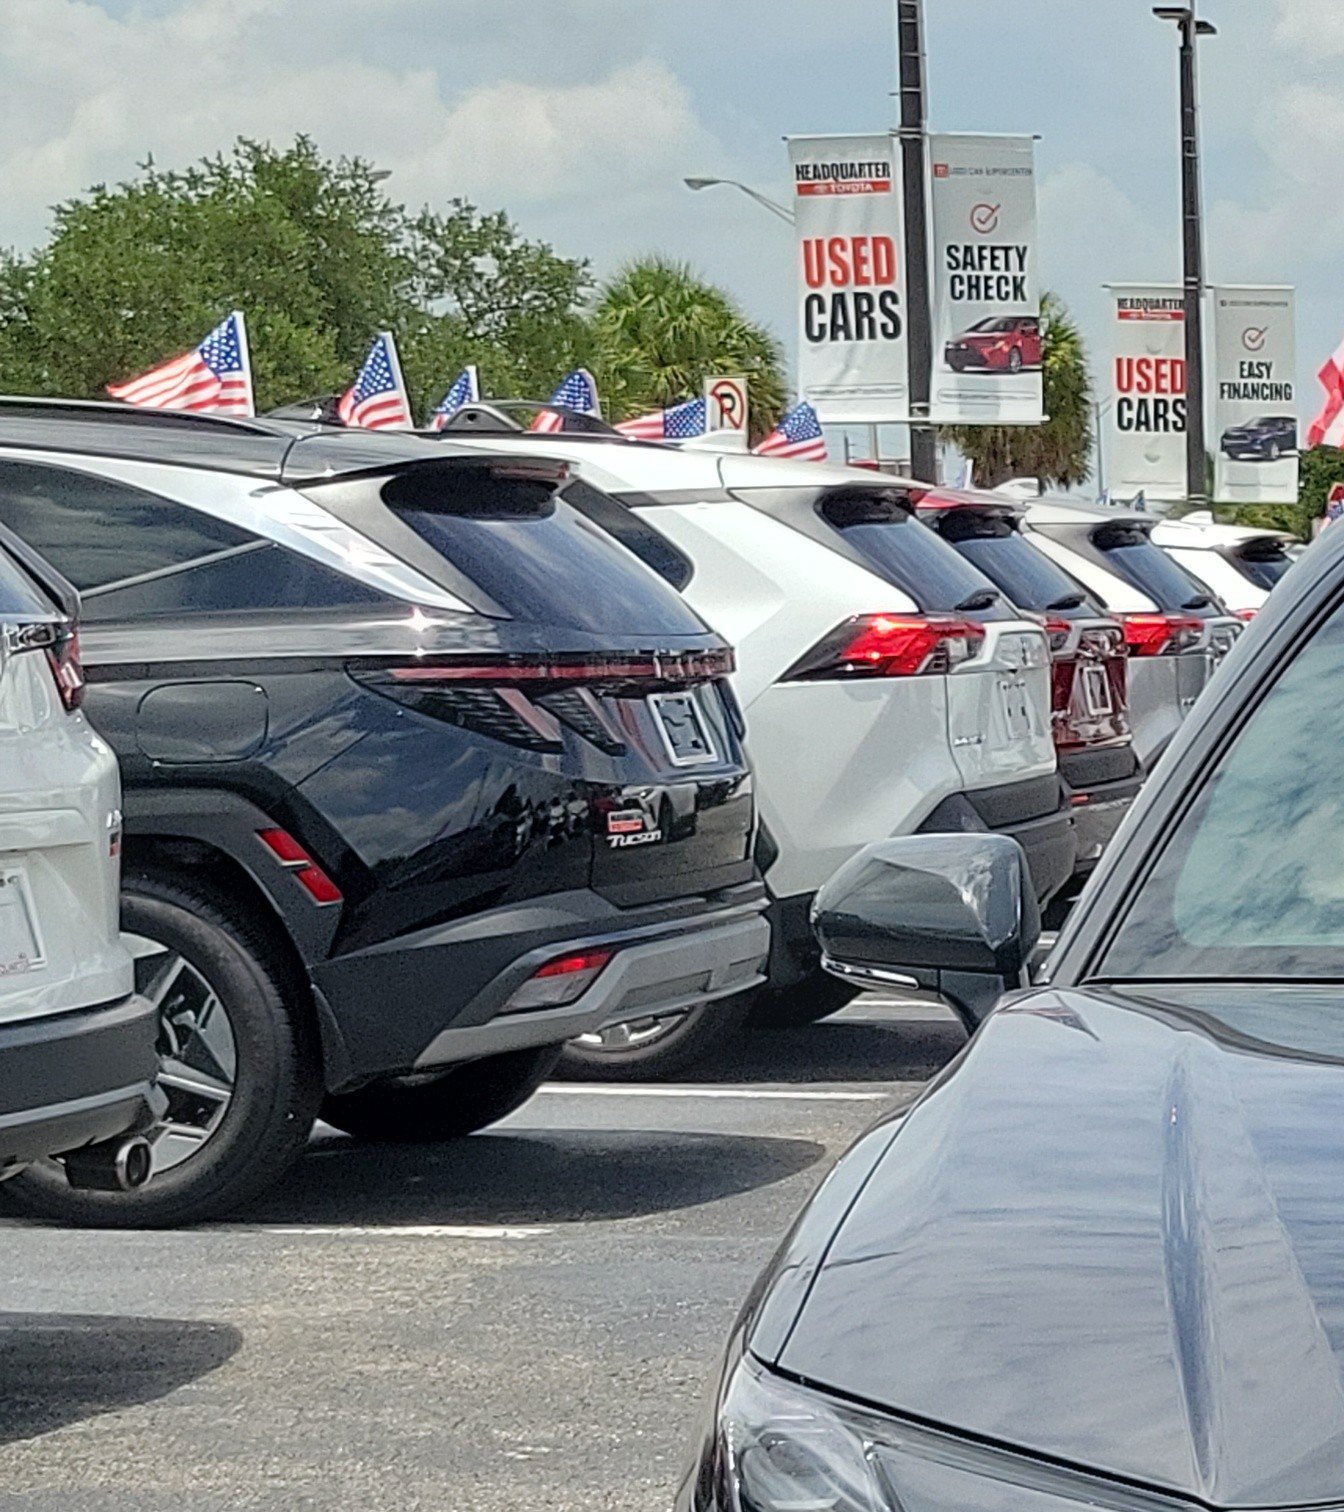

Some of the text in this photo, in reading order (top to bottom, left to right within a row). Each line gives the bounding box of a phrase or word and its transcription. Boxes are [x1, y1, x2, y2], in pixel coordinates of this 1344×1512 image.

[795, 162, 891, 182] HEADQUARTER
[803, 235, 896, 289] USED
[946, 244, 1027, 272] SAFETY
[950, 274, 1027, 302] CHECK
[804, 290, 901, 343] CARS
[1116, 358, 1186, 395] USED
[1239, 360, 1273, 380] EASY
[1219, 382, 1293, 401] FINANCING
[1117, 396, 1186, 433] CARS
